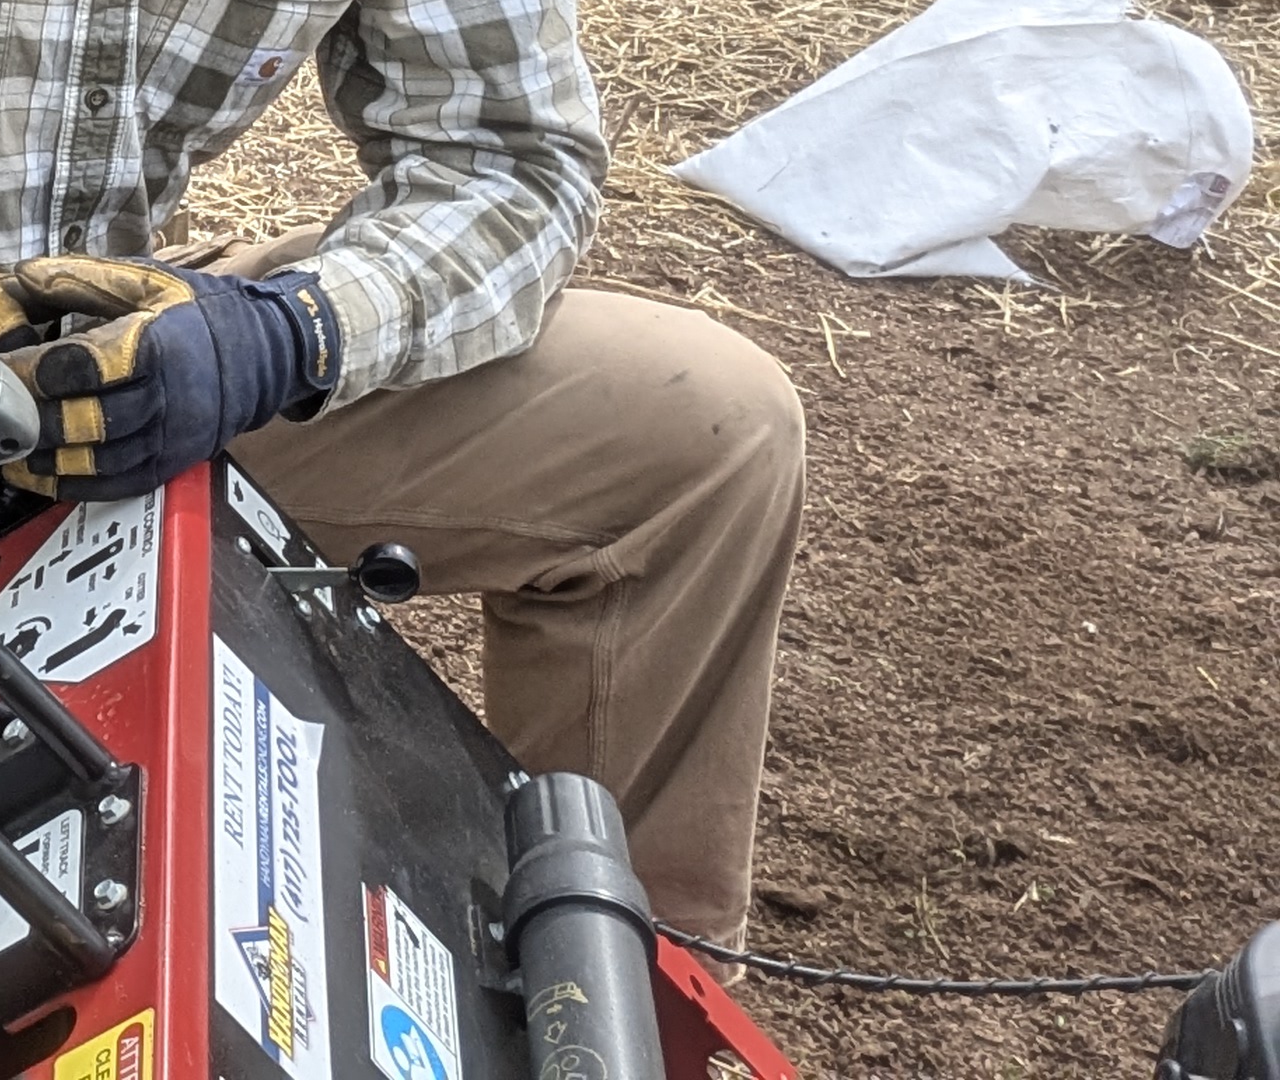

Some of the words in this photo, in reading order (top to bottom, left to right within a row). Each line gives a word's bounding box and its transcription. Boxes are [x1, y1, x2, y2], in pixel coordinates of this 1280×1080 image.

[142, 512, 155, 558] CONTROL
[223, 663, 243, 770] TODAY!
[59, 816, 70, 842] LEFT
[223, 764, 244, 850] RENT
[276, 724, 301, 854] 725-TOOL
[58, 842, 69, 879] TRACK
[279, 847, 309, 923] (417)
[269, 905, 293, 1061] HANDYMAN
[292, 961, 308, 1048] RENTALS
